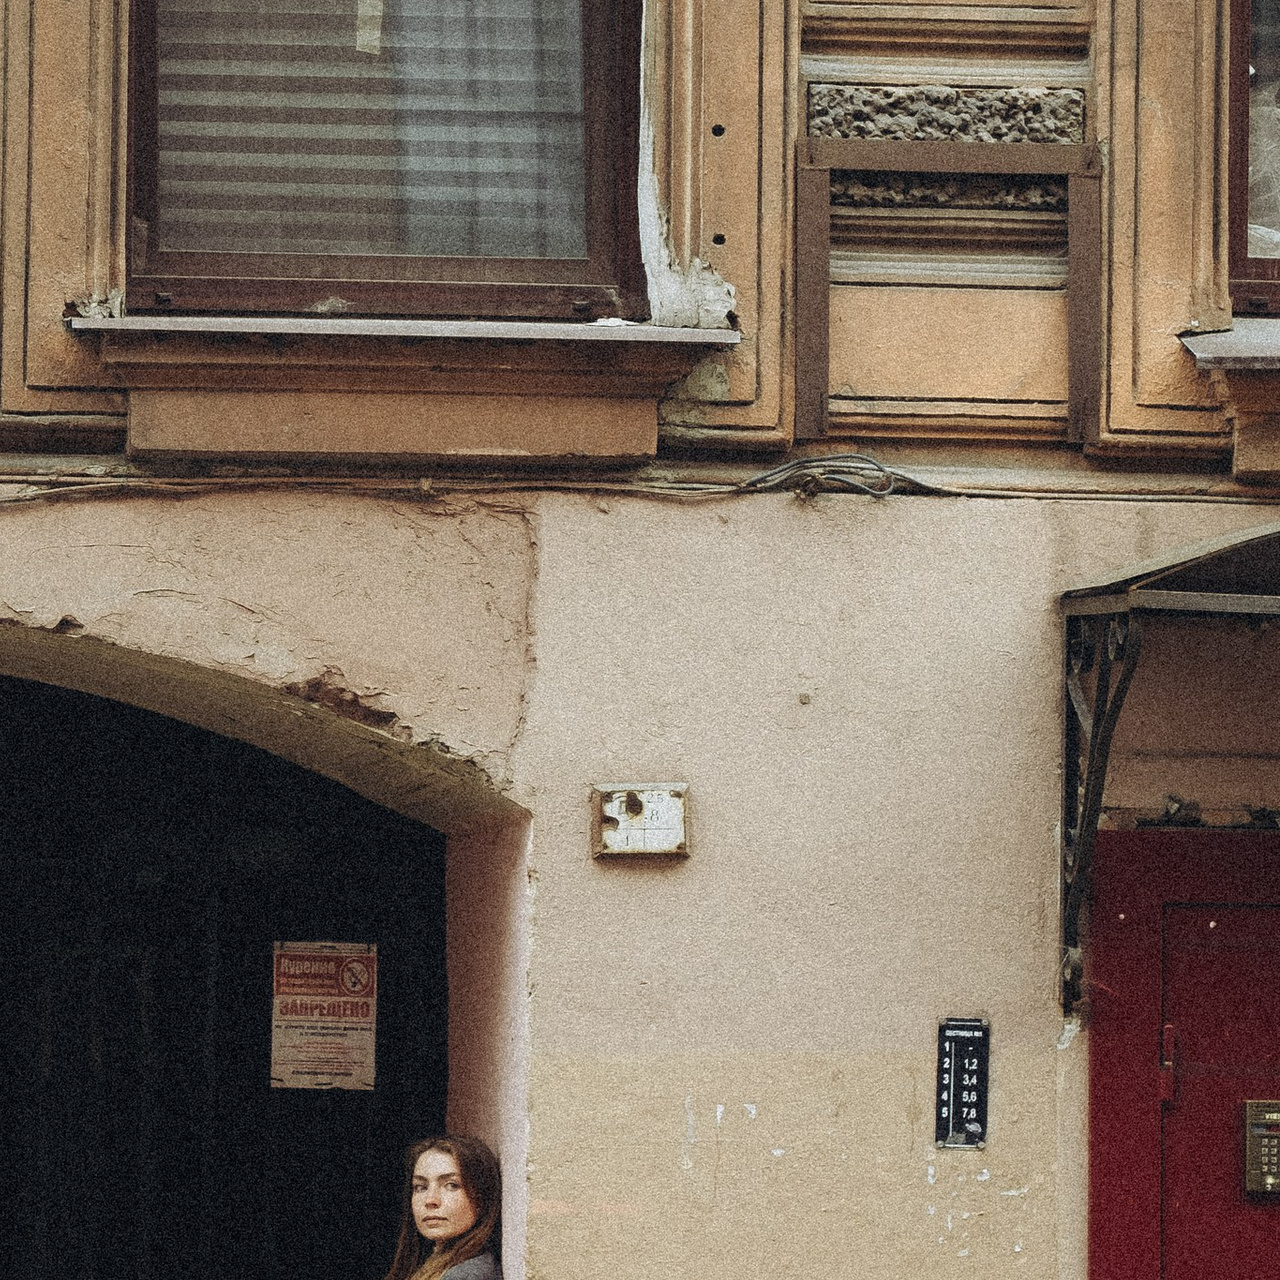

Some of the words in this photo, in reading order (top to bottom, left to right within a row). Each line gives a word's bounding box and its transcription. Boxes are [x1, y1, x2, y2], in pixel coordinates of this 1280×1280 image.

[279, 1000, 371, 1019] ЗАПРЕЩЕНО
[944, 1041, 950, 1052] 1
[943, 1057, 951, 1069] 2
[964, 1058, 978, 1070] 1,2
[942, 1074, 950, 1084] 3
[962, 1074, 978, 1086] 3,4
[941, 1090, 949, 1101] 4
[962, 1091, 978, 1103] 5,6
[941, 1107, 949, 1118] 5
[961, 1108, 977, 1120] 7,8
